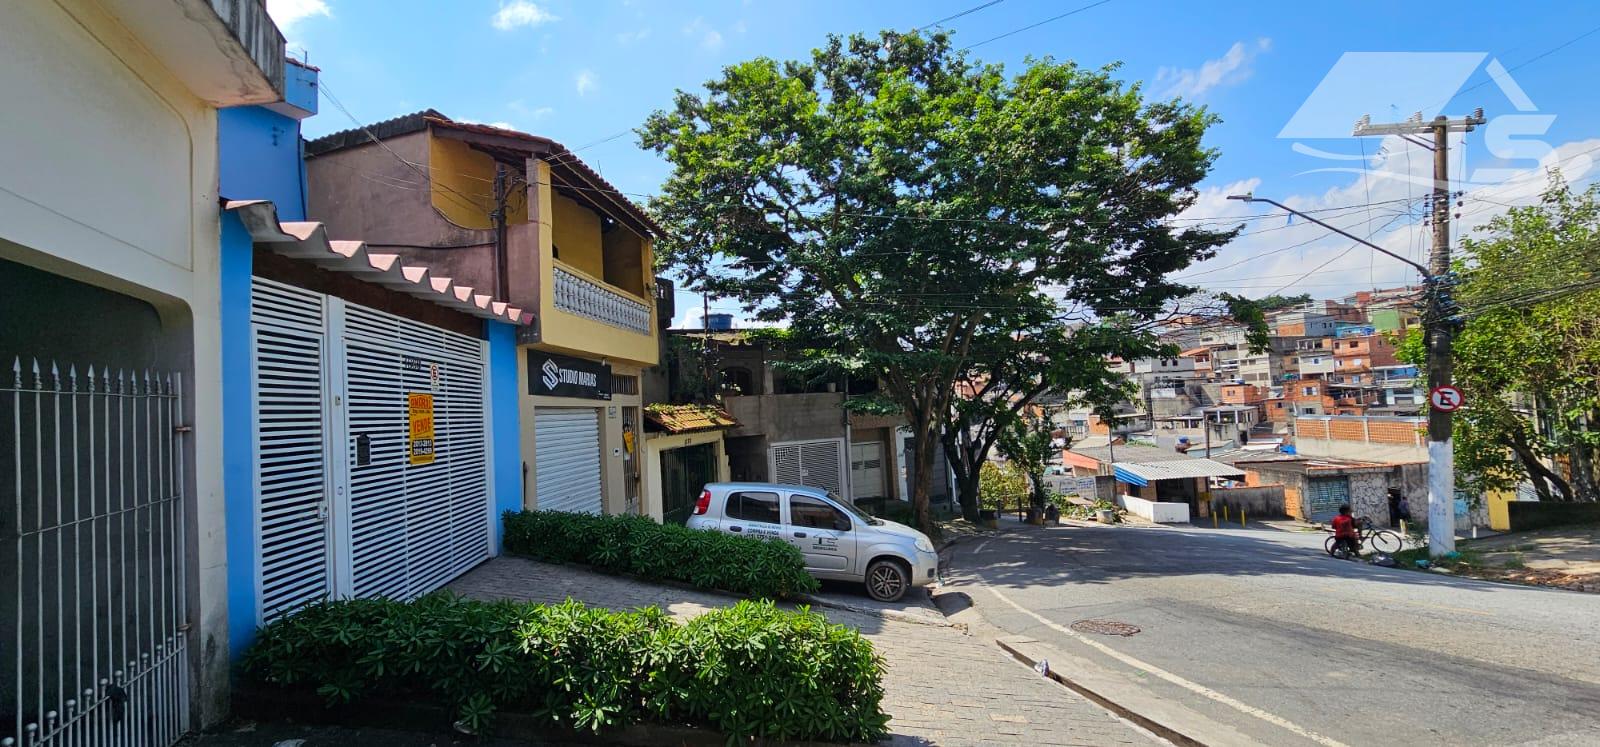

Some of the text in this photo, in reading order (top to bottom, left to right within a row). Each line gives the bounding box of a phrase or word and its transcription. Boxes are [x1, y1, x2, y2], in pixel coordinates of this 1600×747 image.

[559, 368, 597, 387] STUDIO MARIAS
[413, 417, 431, 433] VENDE
